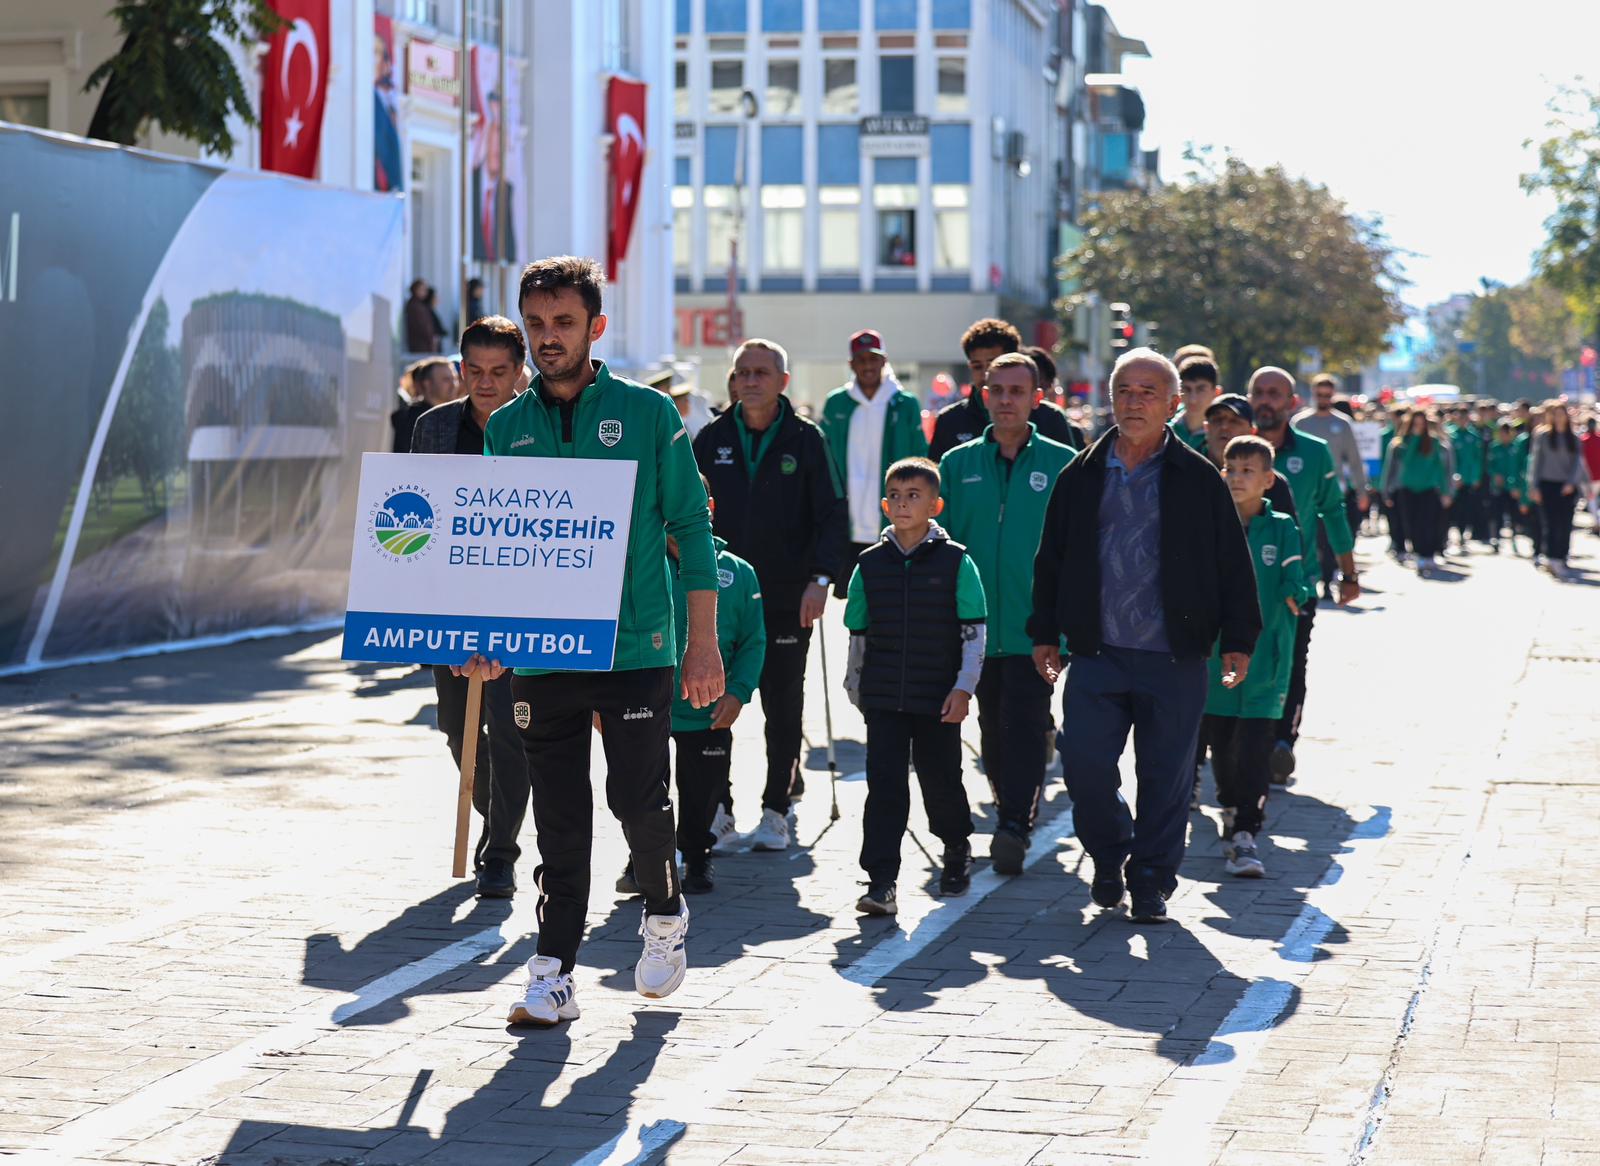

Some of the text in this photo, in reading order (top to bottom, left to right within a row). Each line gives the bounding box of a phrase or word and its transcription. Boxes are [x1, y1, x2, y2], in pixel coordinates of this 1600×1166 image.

[601, 422, 620, 434] SBB
[384, 484, 431, 498] SAKARYA
[454, 487, 573, 509] SAKARYA
[451, 512, 615, 542] BÜYÜKŞEHİR
[449, 544, 594, 569] BELEDİYESİ
[363, 627, 593, 655] AMPUTE FUTBOL
[515, 705, 529, 717] SBB
